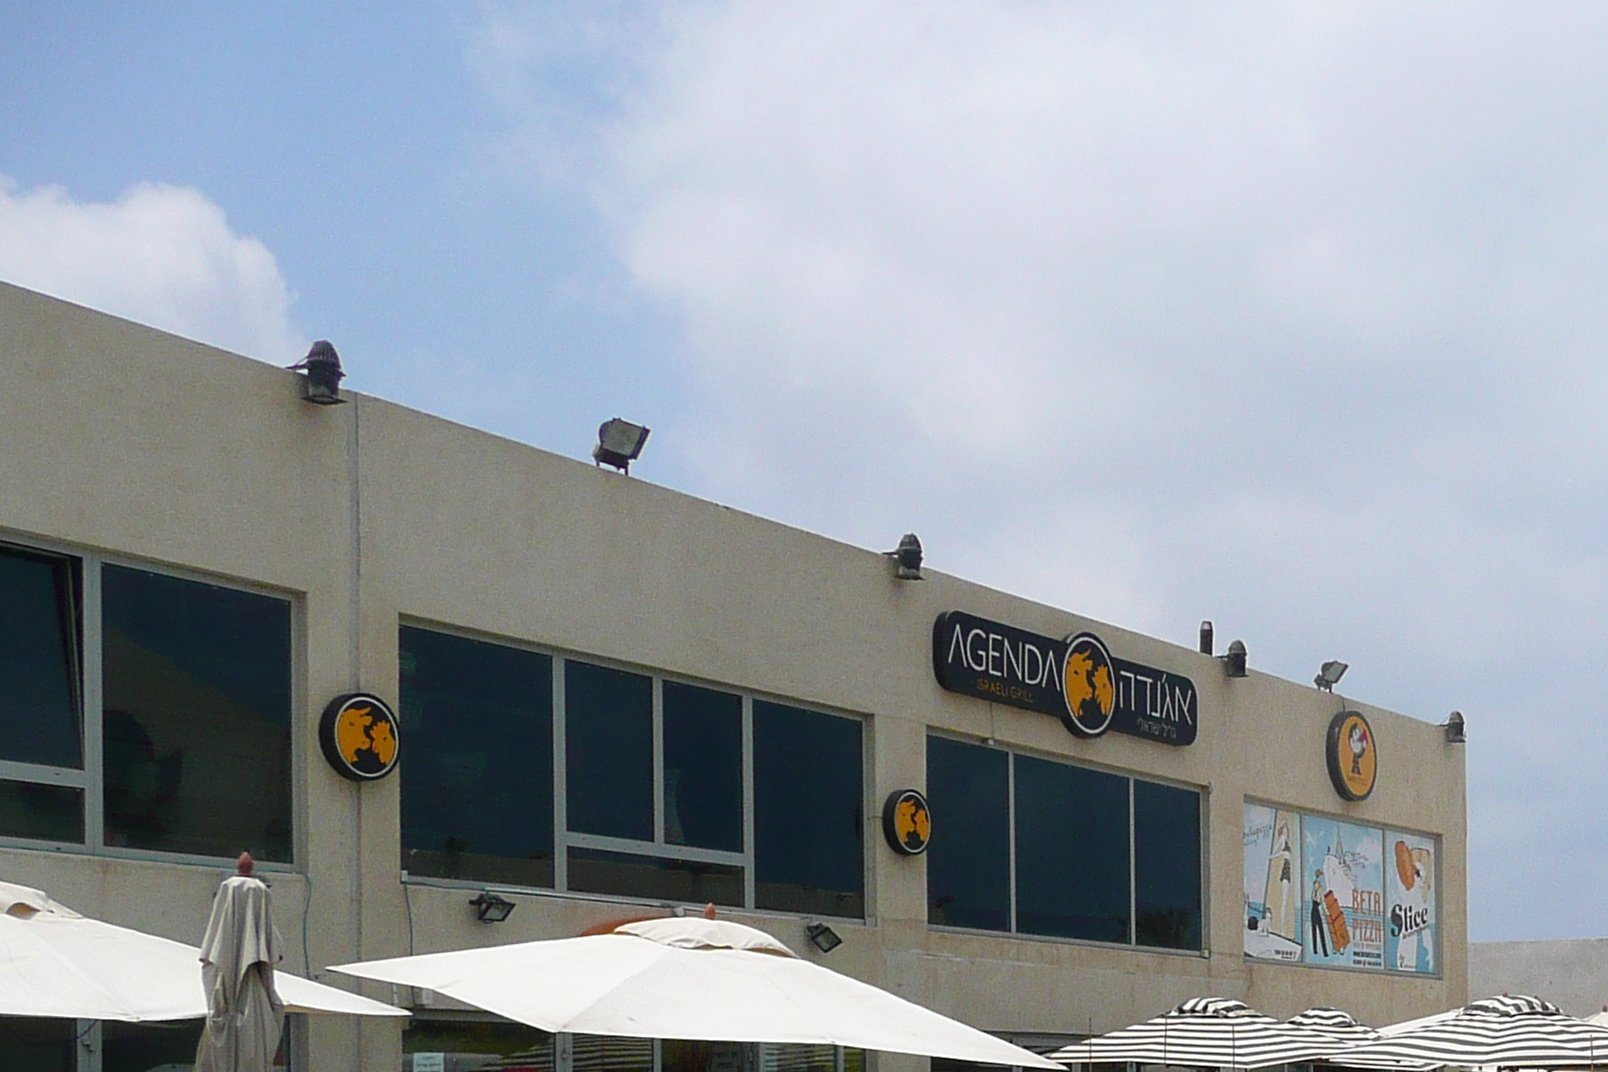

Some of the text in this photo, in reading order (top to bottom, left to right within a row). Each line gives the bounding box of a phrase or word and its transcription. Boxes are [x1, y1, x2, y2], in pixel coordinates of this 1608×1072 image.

[948, 623, 1061, 692] AGENDA
[1353, 889, 1381, 917] BETA
[1353, 918, 1381, 943] PIZZA
[1391, 903, 1428, 937] Slice
